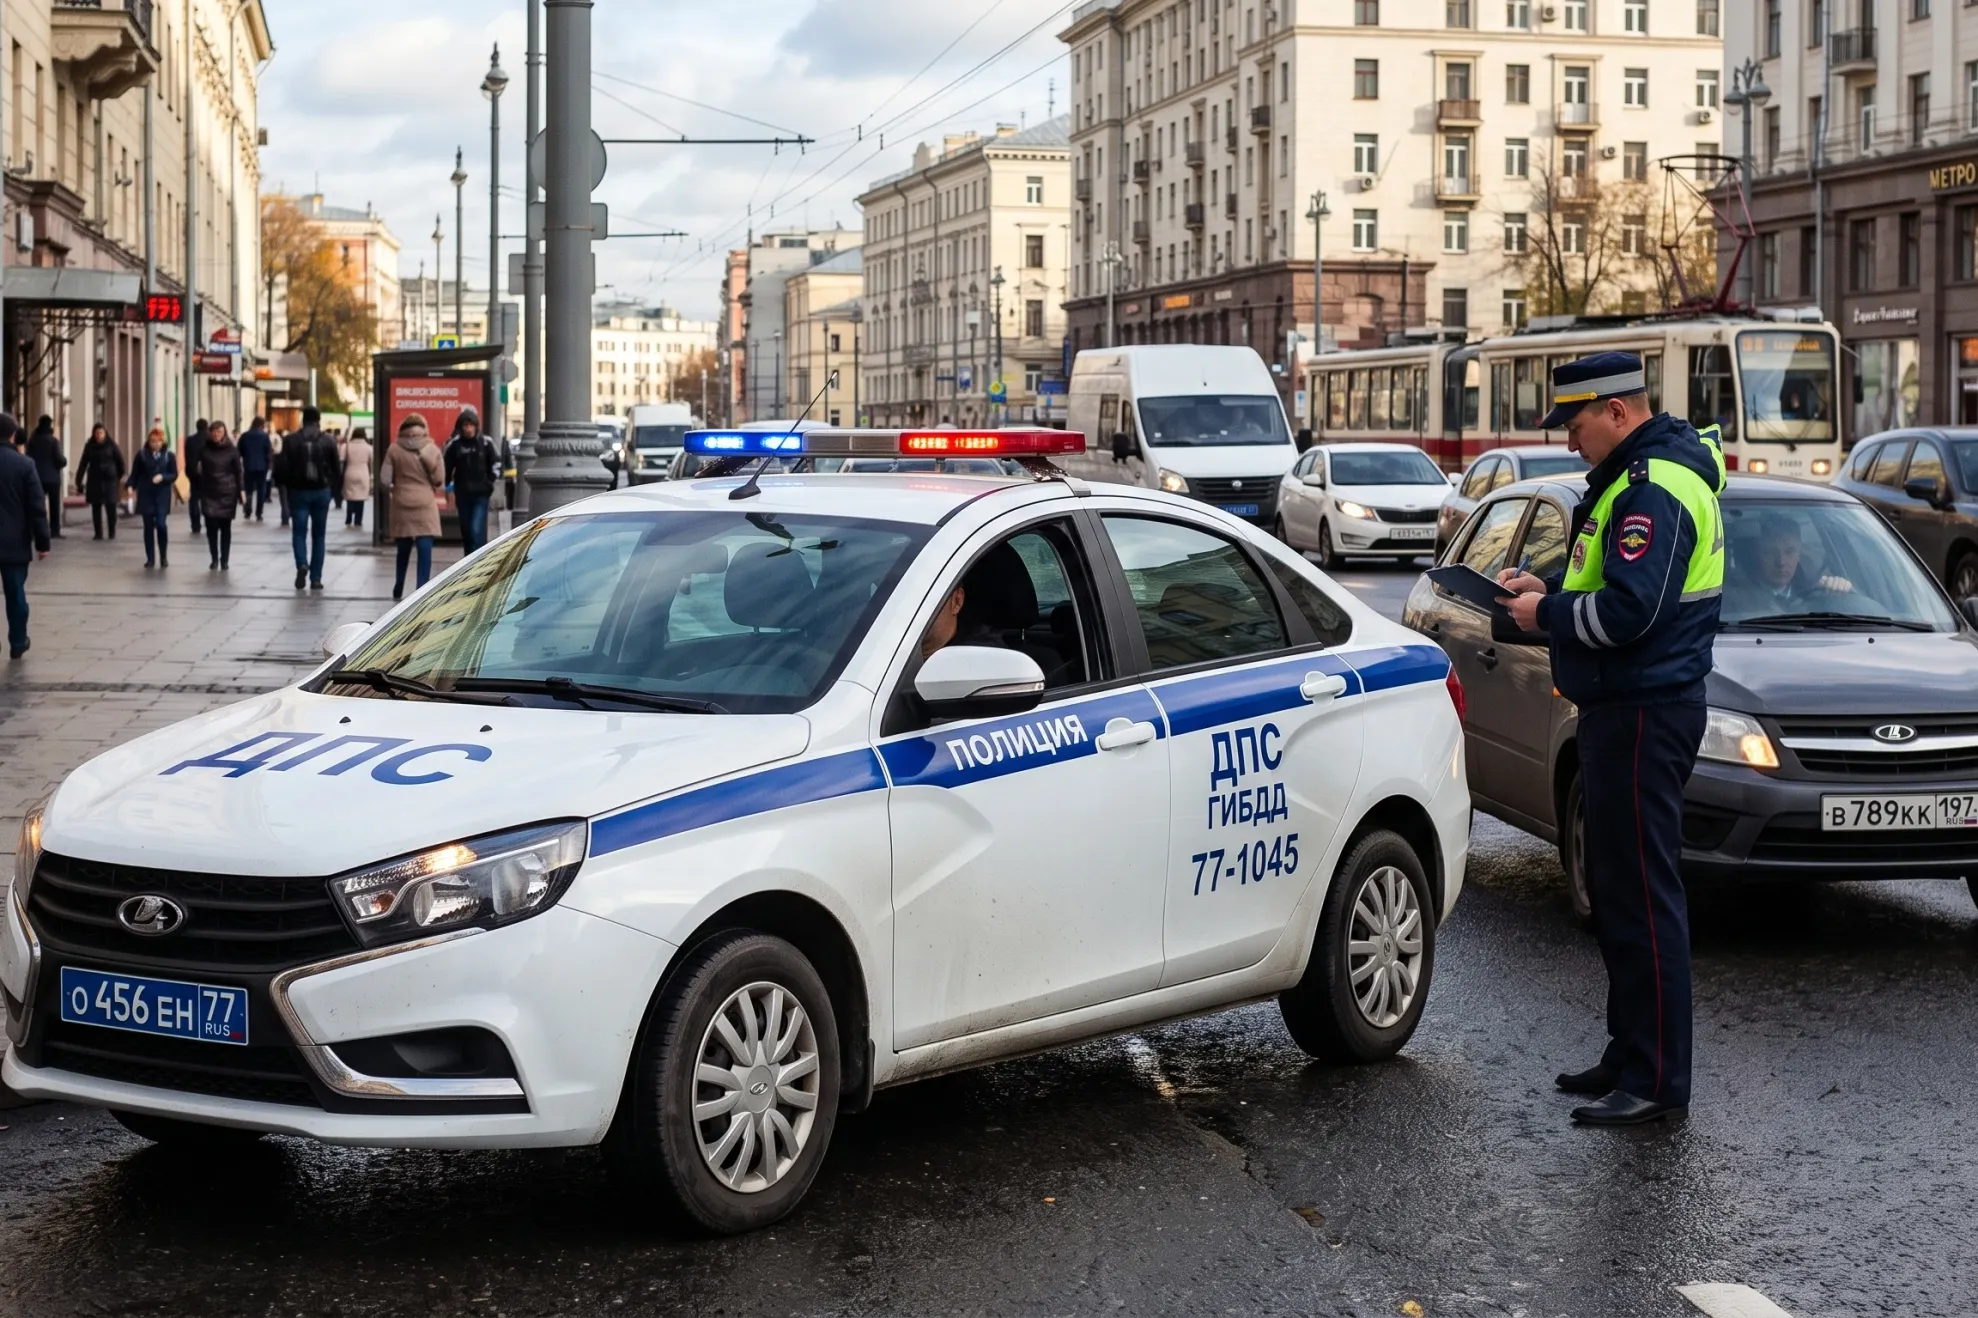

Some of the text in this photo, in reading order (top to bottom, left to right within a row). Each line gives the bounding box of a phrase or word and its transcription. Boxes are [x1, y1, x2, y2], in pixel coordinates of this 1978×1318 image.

[1929, 162, 1976, 189] МЕТРО
[157, 731, 493, 786] ДПС
[945, 714, 1089, 771] ПОЛИЦИЯ
[1210, 722, 1283, 792] ДПС
[1208, 782, 1289, 830] ГИБДД
[1938, 796, 1974, 818] 197
[1946, 817, 1964, 825] RUS
[1192, 833, 1299, 896] 77-1045
[203, 990, 235, 1023] 77
[205, 1023, 231, 1037] RUS
